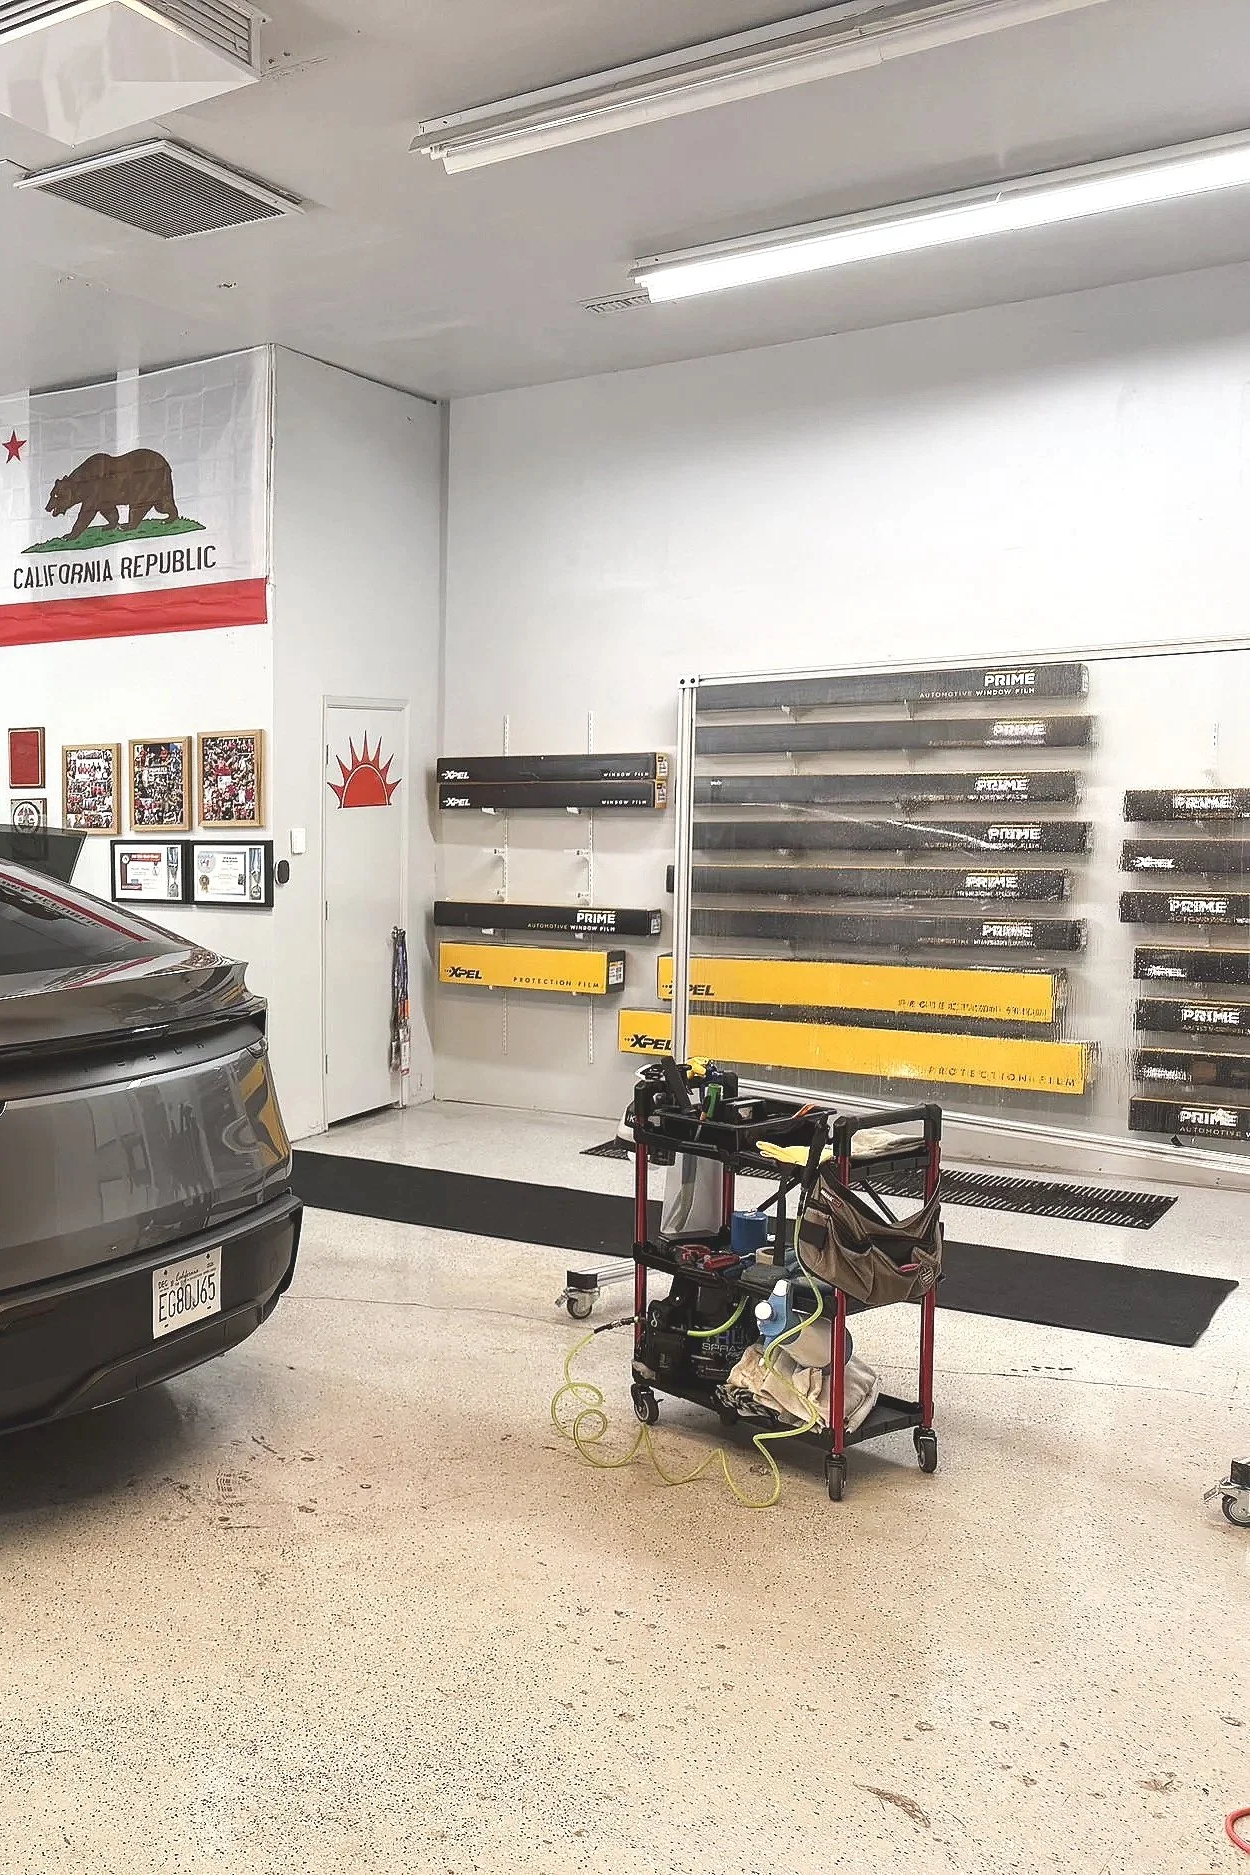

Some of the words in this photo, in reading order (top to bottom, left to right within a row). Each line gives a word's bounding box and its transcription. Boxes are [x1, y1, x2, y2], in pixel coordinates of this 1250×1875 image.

[13, 558, 113, 589] CALIFORNIA
[120, 545, 217, 579] REPUBLIC
[984, 672, 1036, 687] PRIME
[976, 688, 1012, 697] WINDOW
[1015, 687, 1035, 695] FILM
[444, 770, 470, 780] XPEL
[445, 797, 471, 807] XPEL
[576, 911, 616, 924] PRIME
[527, 922, 568, 930] AUTOMOTIVE
[570, 924, 598, 932] WINDOW
[448, 966, 482, 979] XPEL
[513, 976, 572, 987] PROTECTION
[577, 980, 600, 989] FILM
[670, 984, 715, 996] PEL
[1181, 1008, 1240, 1024] PRIME
[630, 1034, 673, 1051] XPEL
[1179, 1110, 1239, 1127] PRIME
[158, 1273, 216, 1323] EG80J65
